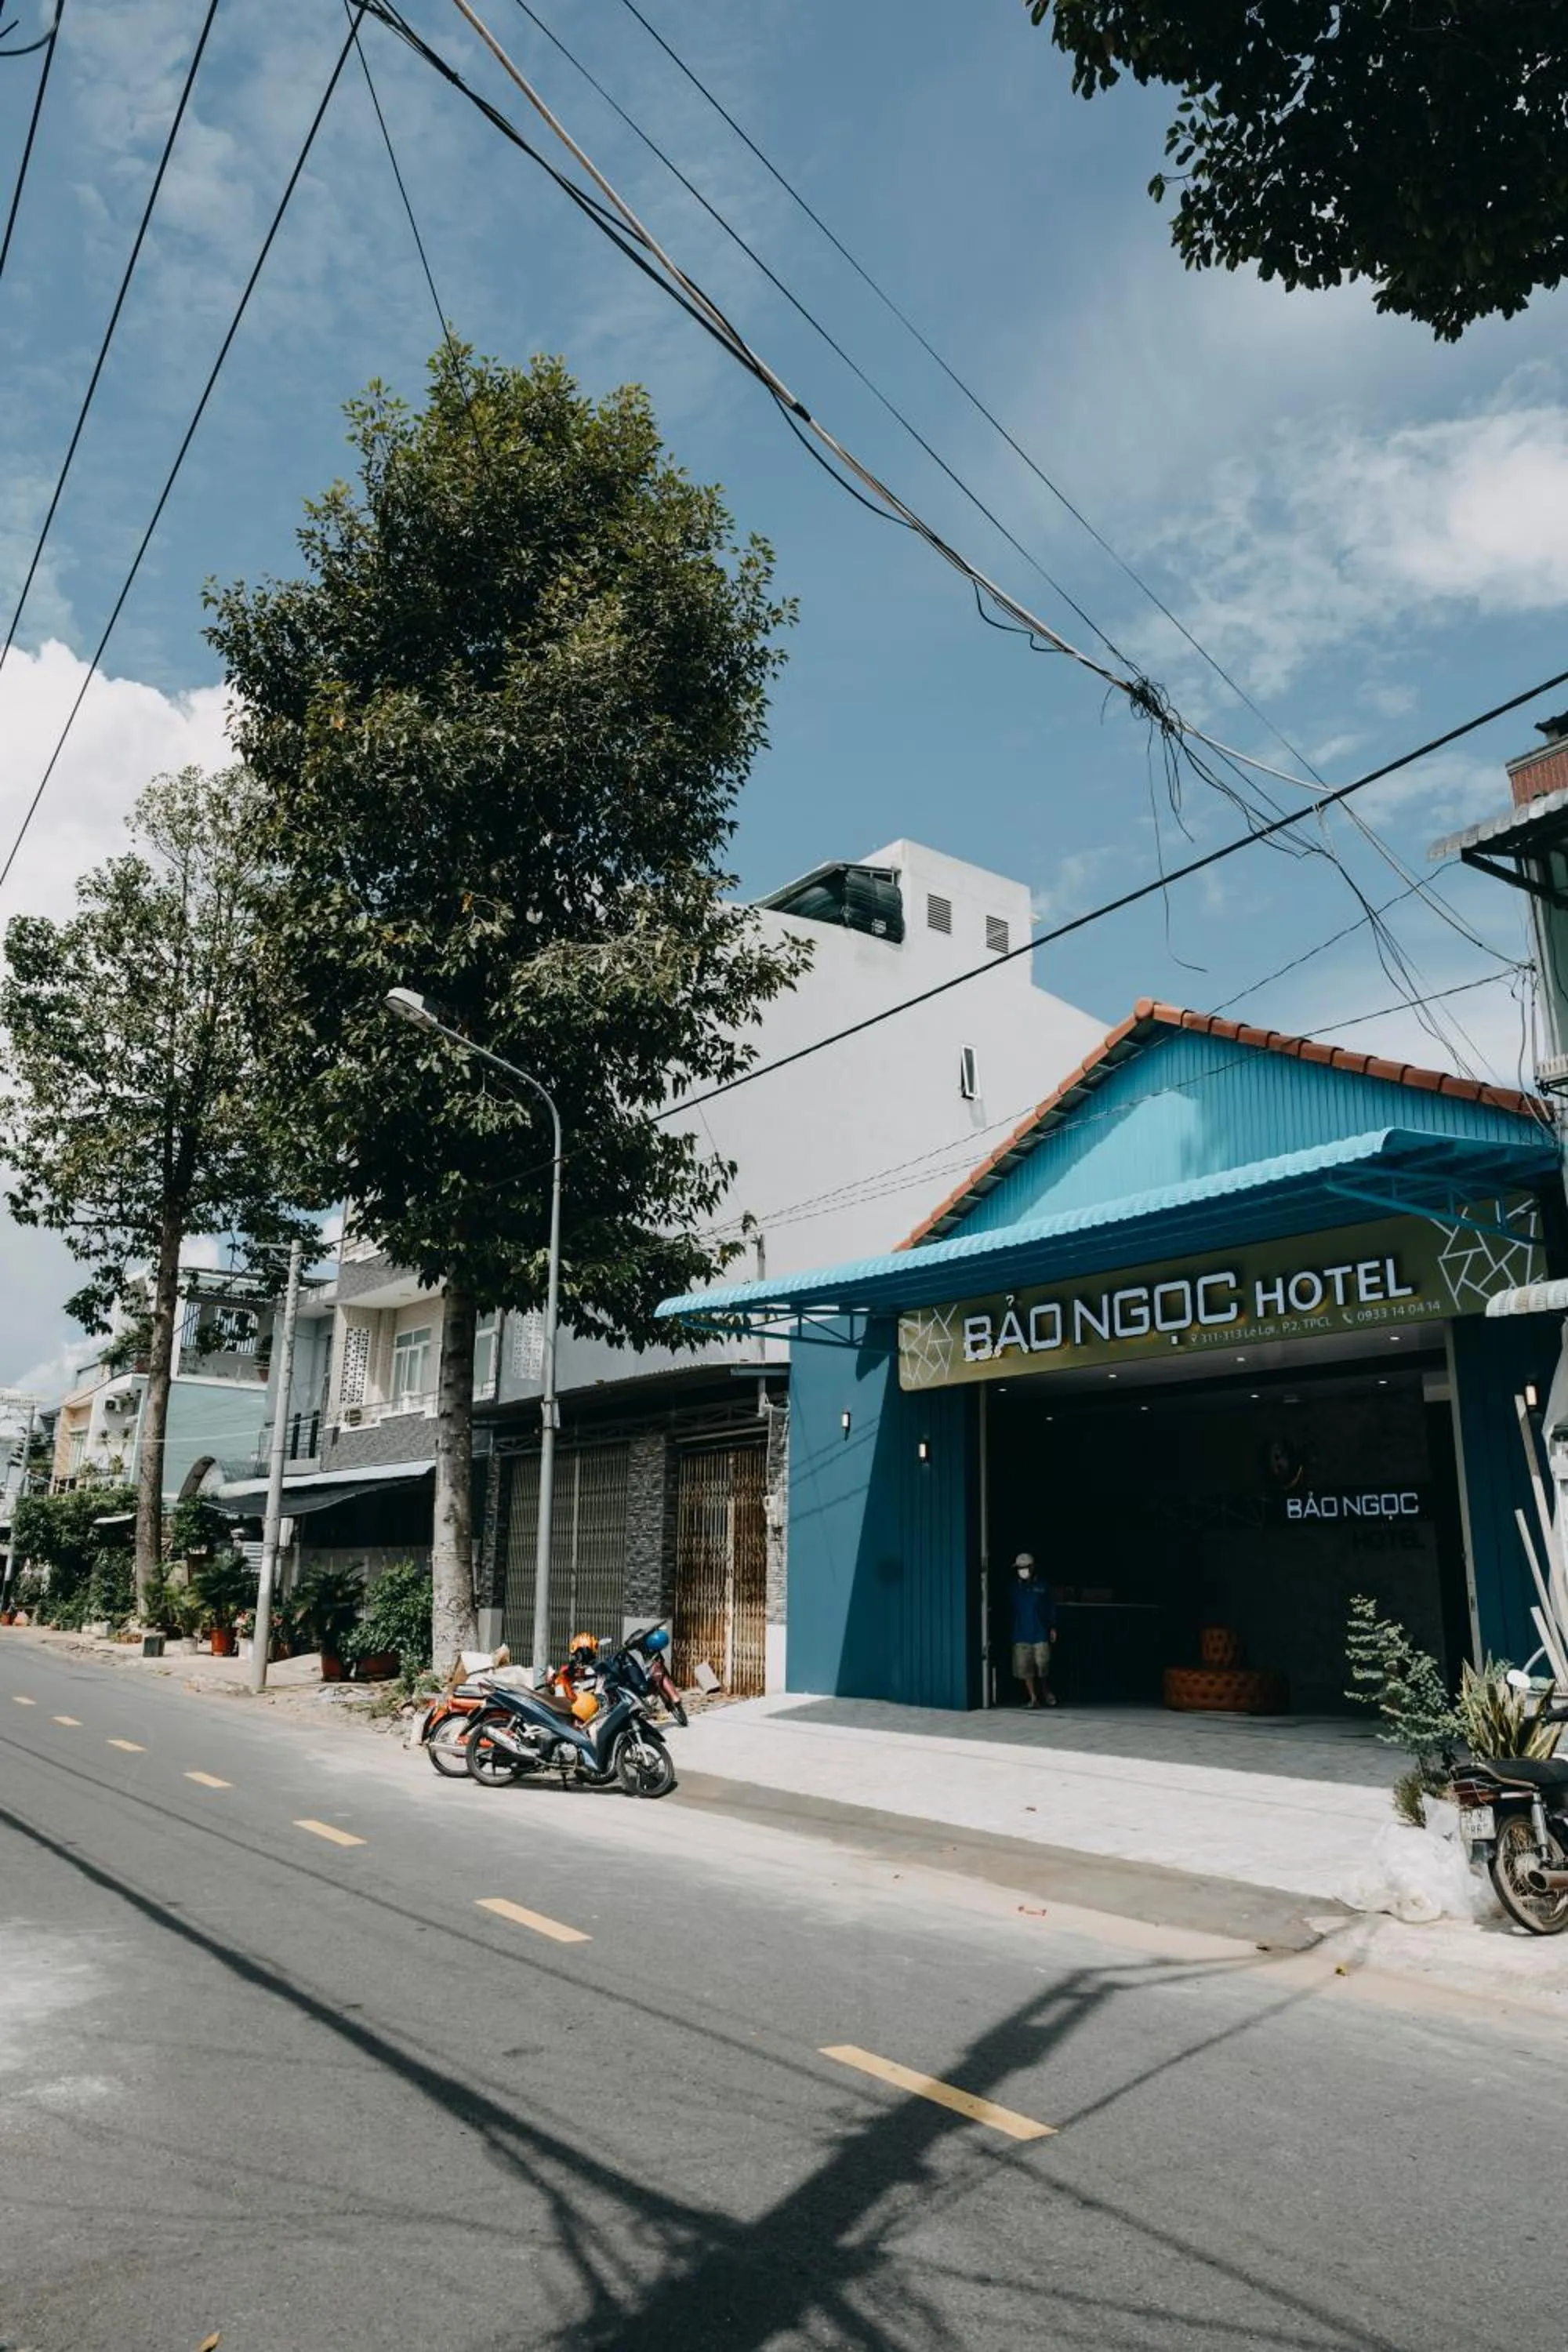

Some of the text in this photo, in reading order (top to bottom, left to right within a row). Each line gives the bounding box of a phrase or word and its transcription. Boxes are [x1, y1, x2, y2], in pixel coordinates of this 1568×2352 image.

[963, 1258, 1414, 1363] BẢO NGỌC HOTEL
[1287, 1491, 1419, 1520] BẢO NGỌC
